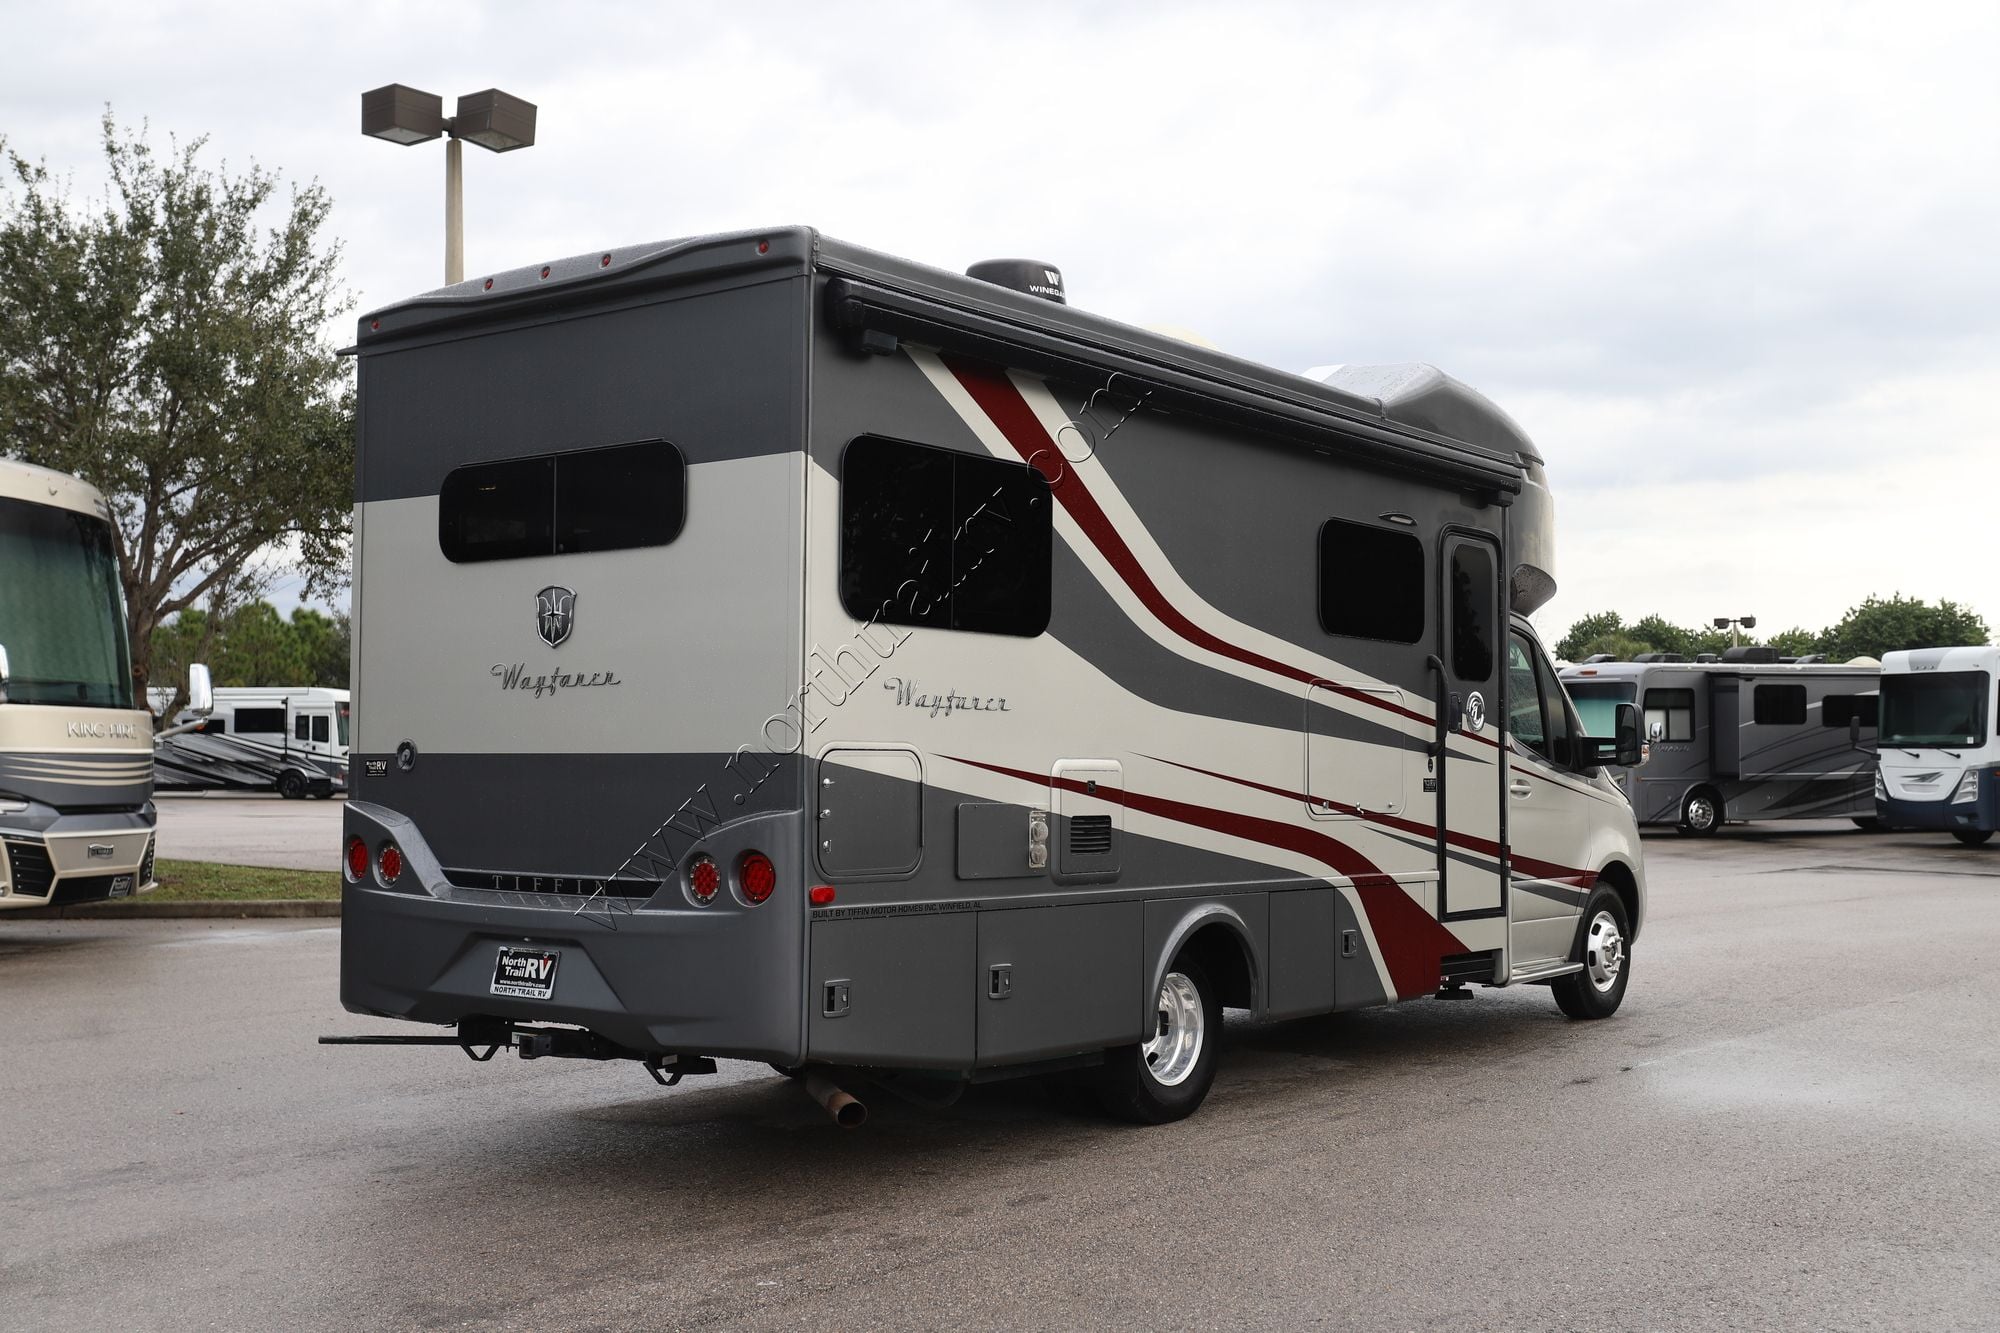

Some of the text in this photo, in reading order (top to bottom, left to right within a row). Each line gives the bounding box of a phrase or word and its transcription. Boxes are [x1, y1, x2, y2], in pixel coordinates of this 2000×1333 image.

[489, 662, 621, 699] Wayfarer
[883, 677, 1012, 718] Wayfarer
[67, 721, 105, 738] KING
[492, 874, 607, 896] TIFFIN
[812, 909, 833, 918] BUILT
[835, 908, 846, 917] BY
[848, 907, 870, 916] TIFFIN
[871, 905, 897, 914] MOTOR
[898, 904, 923, 913] HOMES
[502, 955, 526, 967] North
[524, 958, 552, 979] RV
[505, 966, 525, 977] Trail
[494, 986, 516, 995] NORTH
[517, 988, 536, 996] TRAIL
